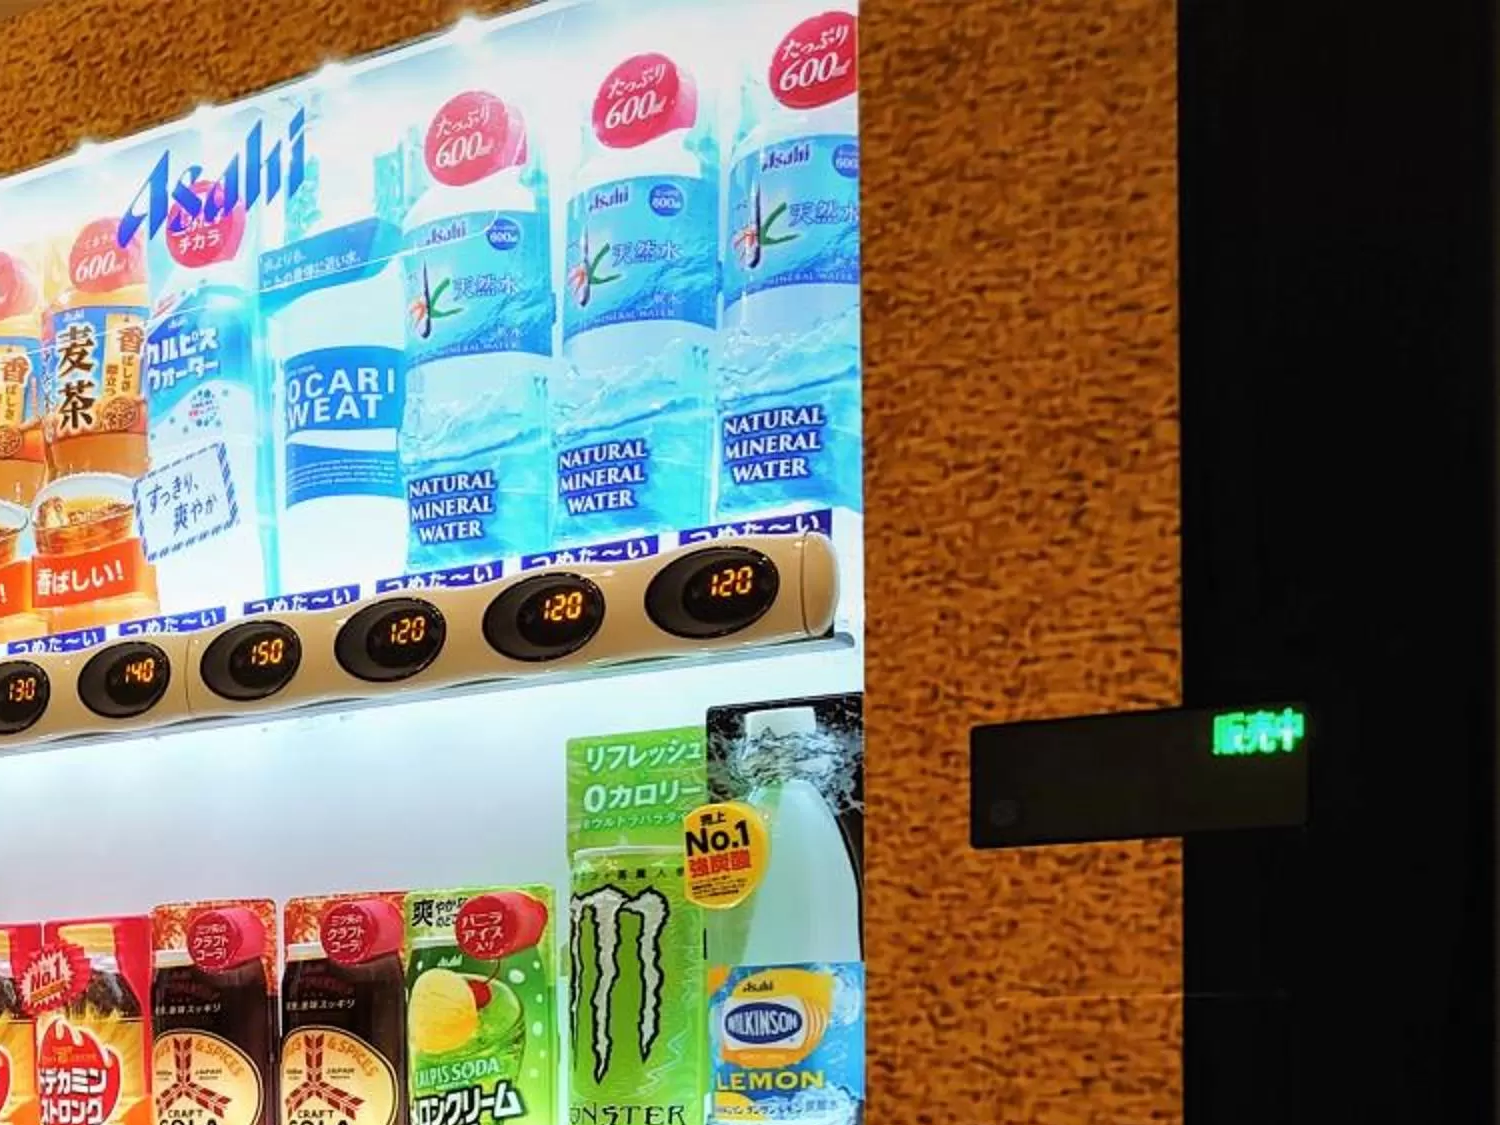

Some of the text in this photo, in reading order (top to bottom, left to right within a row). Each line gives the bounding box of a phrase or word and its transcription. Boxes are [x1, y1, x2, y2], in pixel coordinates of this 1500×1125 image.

[781, 25, 848, 61] たっぷり
[607, 63, 666, 99] たっぷり
[117, 106, 305, 248] Asahi
[56, 326, 95, 429] 麦茶
[724, 405, 826, 440] NATURAL
[558, 438, 646, 471] NATURAL
[724, 432, 822, 460] MINERAL
[407, 470, 495, 499] NATURAL
[559, 464, 645, 494] MINERAL
[731, 458, 809, 485] WATER
[409, 495, 493, 525] MINERAL
[566, 488, 634, 515] WATER
[418, 520, 483, 545] WATER
[711, 567, 753, 598] 120
[543, 592, 582, 622] 120
[390, 617, 425, 645] 120
[250, 639, 283, 665] 150
[124, 659, 156, 684] 140
[8, 678, 36, 703] 130
[586, 741, 700, 771] リフレッシュ
[584, 783, 705, 812] 0カロリー
[684, 818, 751, 857] No.1
[726, 1005, 799, 1037] WILKINSON
[452, 1055, 499, 1082] SODA
[717, 1069, 825, 1092] LEMON
